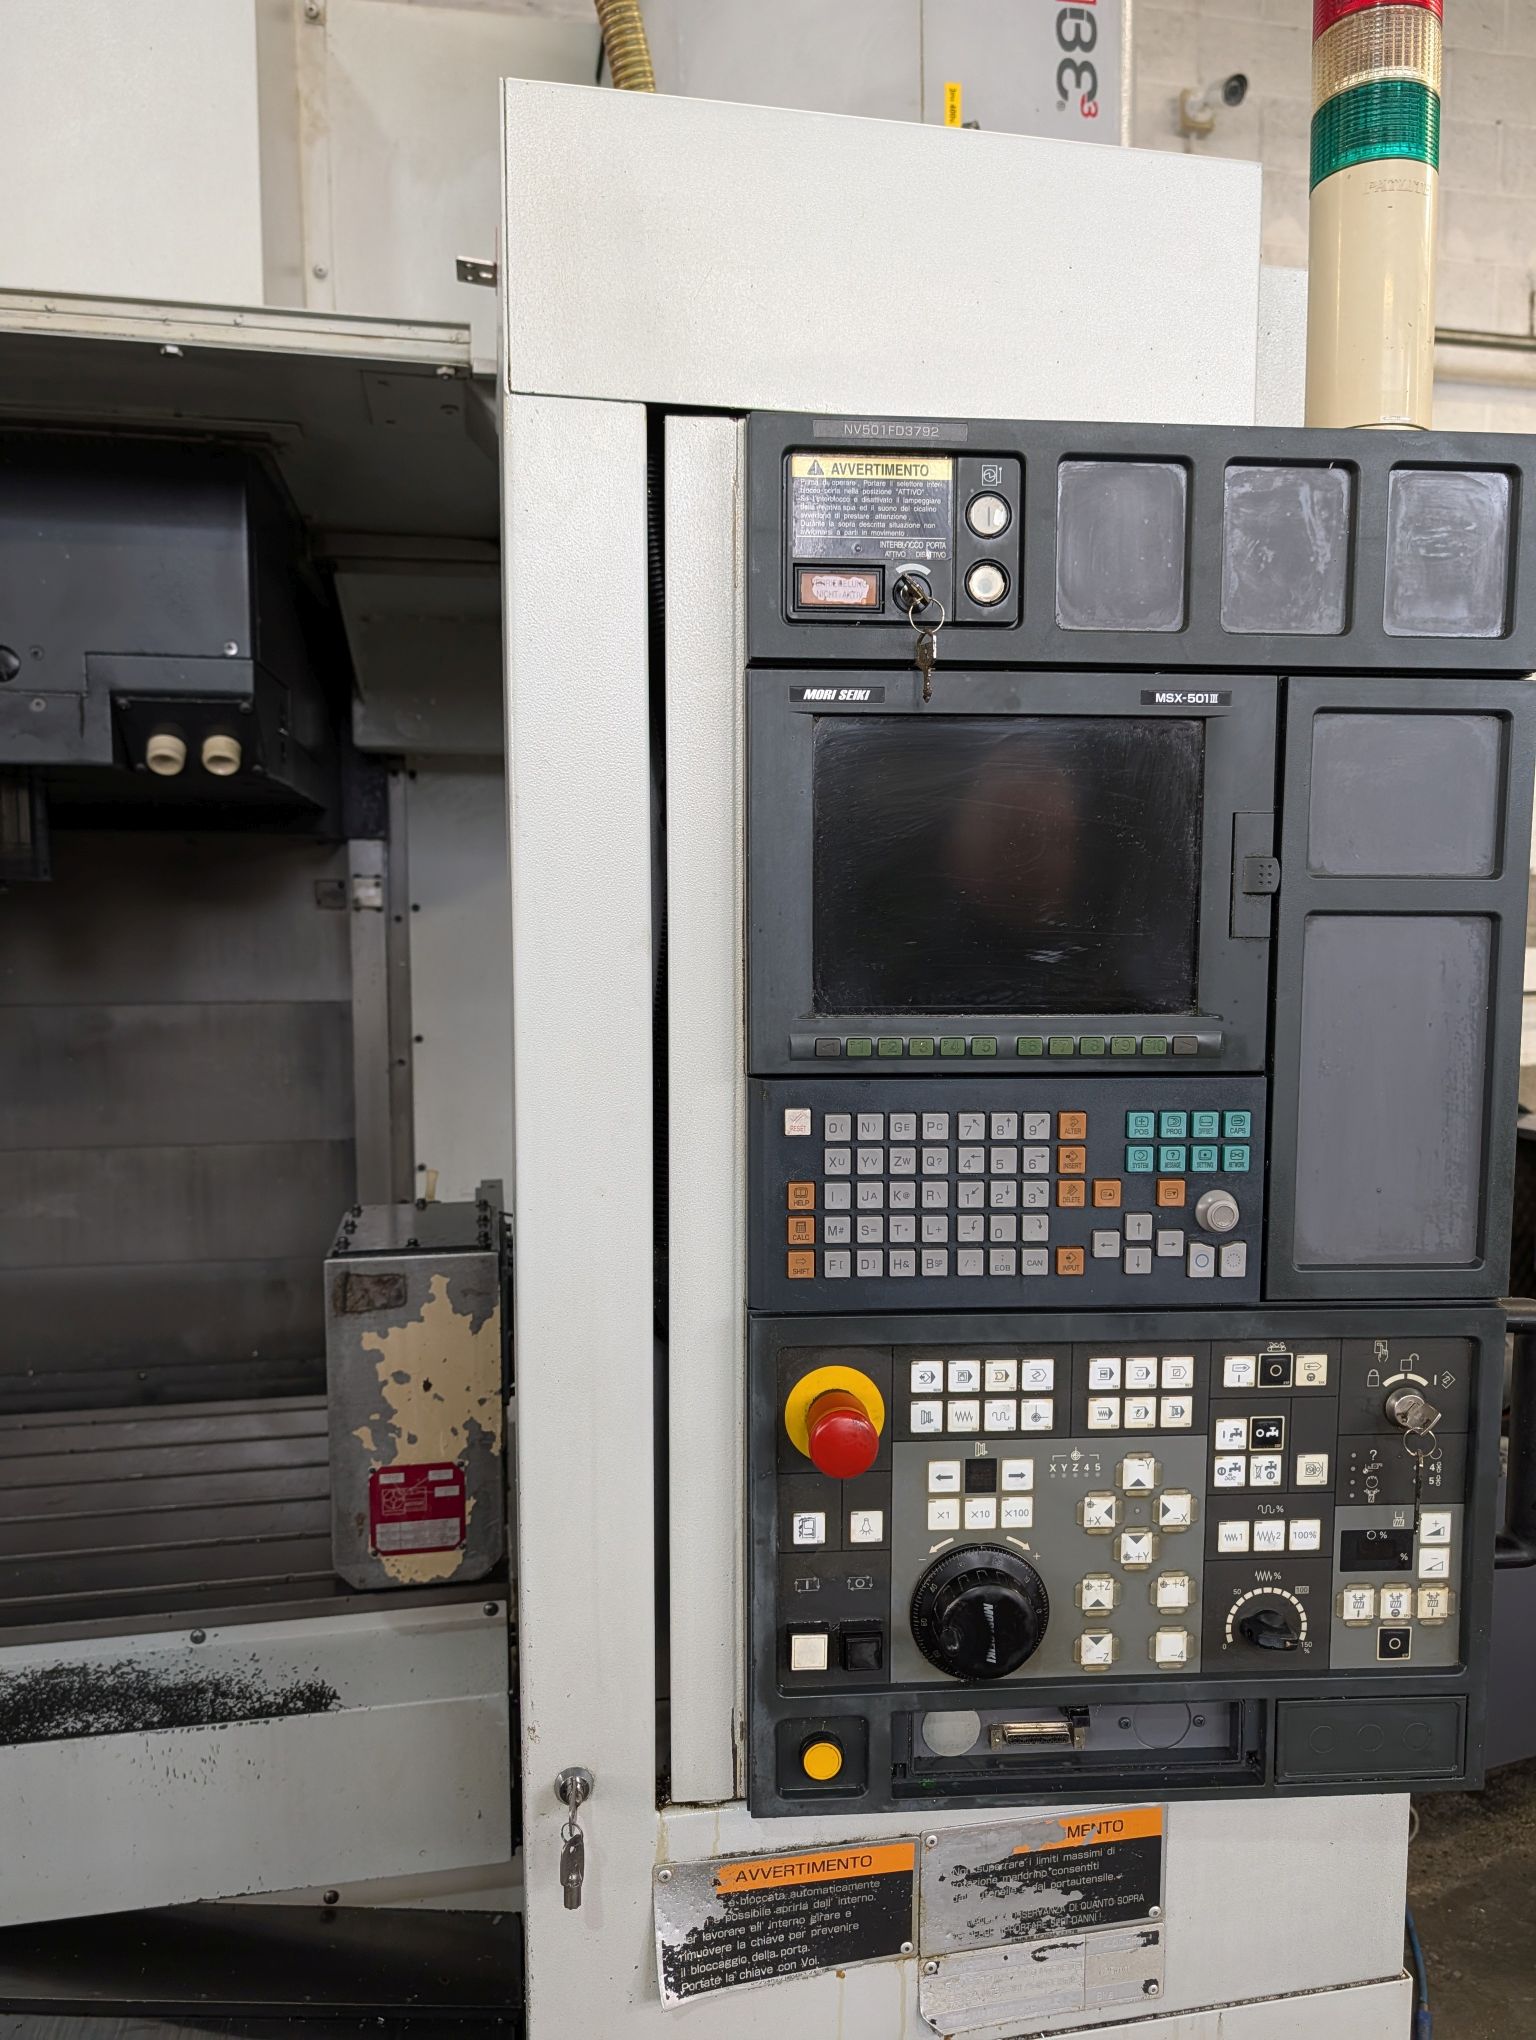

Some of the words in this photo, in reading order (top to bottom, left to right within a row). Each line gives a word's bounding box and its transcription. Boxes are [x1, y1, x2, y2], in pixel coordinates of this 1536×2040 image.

[843, 424, 939, 437] NV501FD3792
[831, 462, 929, 477] AVVERTIMENTO
[863, 488, 892, 496] posizione
[903, 497, 942, 505] lampeggiare
[880, 541, 924, 549] INTERBLOCCO
[926, 541, 947, 550] PORTA
[885, 550, 906, 558] ATTIVO
[803, 689, 836, 701] MORI
[838, 689, 872, 701] SEIKI
[790, 1125, 806, 1133] RESET
[963, 1125, 972, 1136] 7
[996, 1124, 1005, 1136] 8
[1028, 1124, 1037, 1136] 9
[963, 1159, 972, 1170] 4
[996, 1159, 1004, 1170] 5
[1028, 1159, 1037, 1170] 6
[964, 1193, 971, 1205] 1
[995, 1193, 1004, 1204] 2
[1028, 1193, 1036, 1204] 3
[995, 1228, 1003, 1238] 0
[1027, 1259, 1043, 1267] CAN
[1062, 1264, 1080, 1272] INPUT
[1050, 1464, 1056, 1472] X
[1061, 1463, 1067, 1471] Y
[1072, 1463, 1078, 1471] Z
[1083, 1463, 1090, 1471] 4
[1095, 1463, 1101, 1471] 5
[1429, 1464, 1435, 1472] 4
[1429, 1477, 1434, 1485] 5
[1086, 1515, 1101, 1526] +X
[1293, 1531, 1317, 1541] 100%
[1135, 1552, 1149, 1562] +Y
[1233, 1588, 1242, 1596] 50
[1036, 1855, 1059, 1867] limiti
[1063, 1849, 1103, 1862] massimi
[1107, 1847, 1116, 1855] di
[735, 1854, 873, 1883] AVVERTIMENTO
[1002, 1867, 1048, 1882] mandrino
[1051, 1861, 1100, 1875] consentiti
[740, 1891, 785, 1906] bloccata
[789, 1879, 881, 1900] automaticamente
[1069, 1902, 1078, 1912] DI
[1080, 1898, 1115, 1911] QUANTO
[1117, 1893, 1145, 1906] SOPRA
[725, 1908, 772, 1924] possibile
[776, 1902, 809, 1916] aprirla
[837, 1893, 877, 1905] interno.
[702, 1925, 746, 1941] lavorare
[768, 1915, 806, 1930] interno
[810, 1910, 841, 1926] girare
[845, 1910, 852, 1918] e
[678, 1944, 732, 1962] rimuovere
[736, 1939, 746, 1950] la
[750, 1933, 785, 1949] chiave
[788, 1929, 807, 1942] per
[810, 1921, 860, 1936] prevenire
[680, 1966, 686, 1977] il
[780, 1943, 811, 1959] porta.
[681, 1976, 721, 1993] Portate
[725, 1971, 735, 1982] la
[739, 1964, 774, 1980] chiave
[778, 1961, 797, 1971] con
[800, 1956, 820, 1969] Voi.
